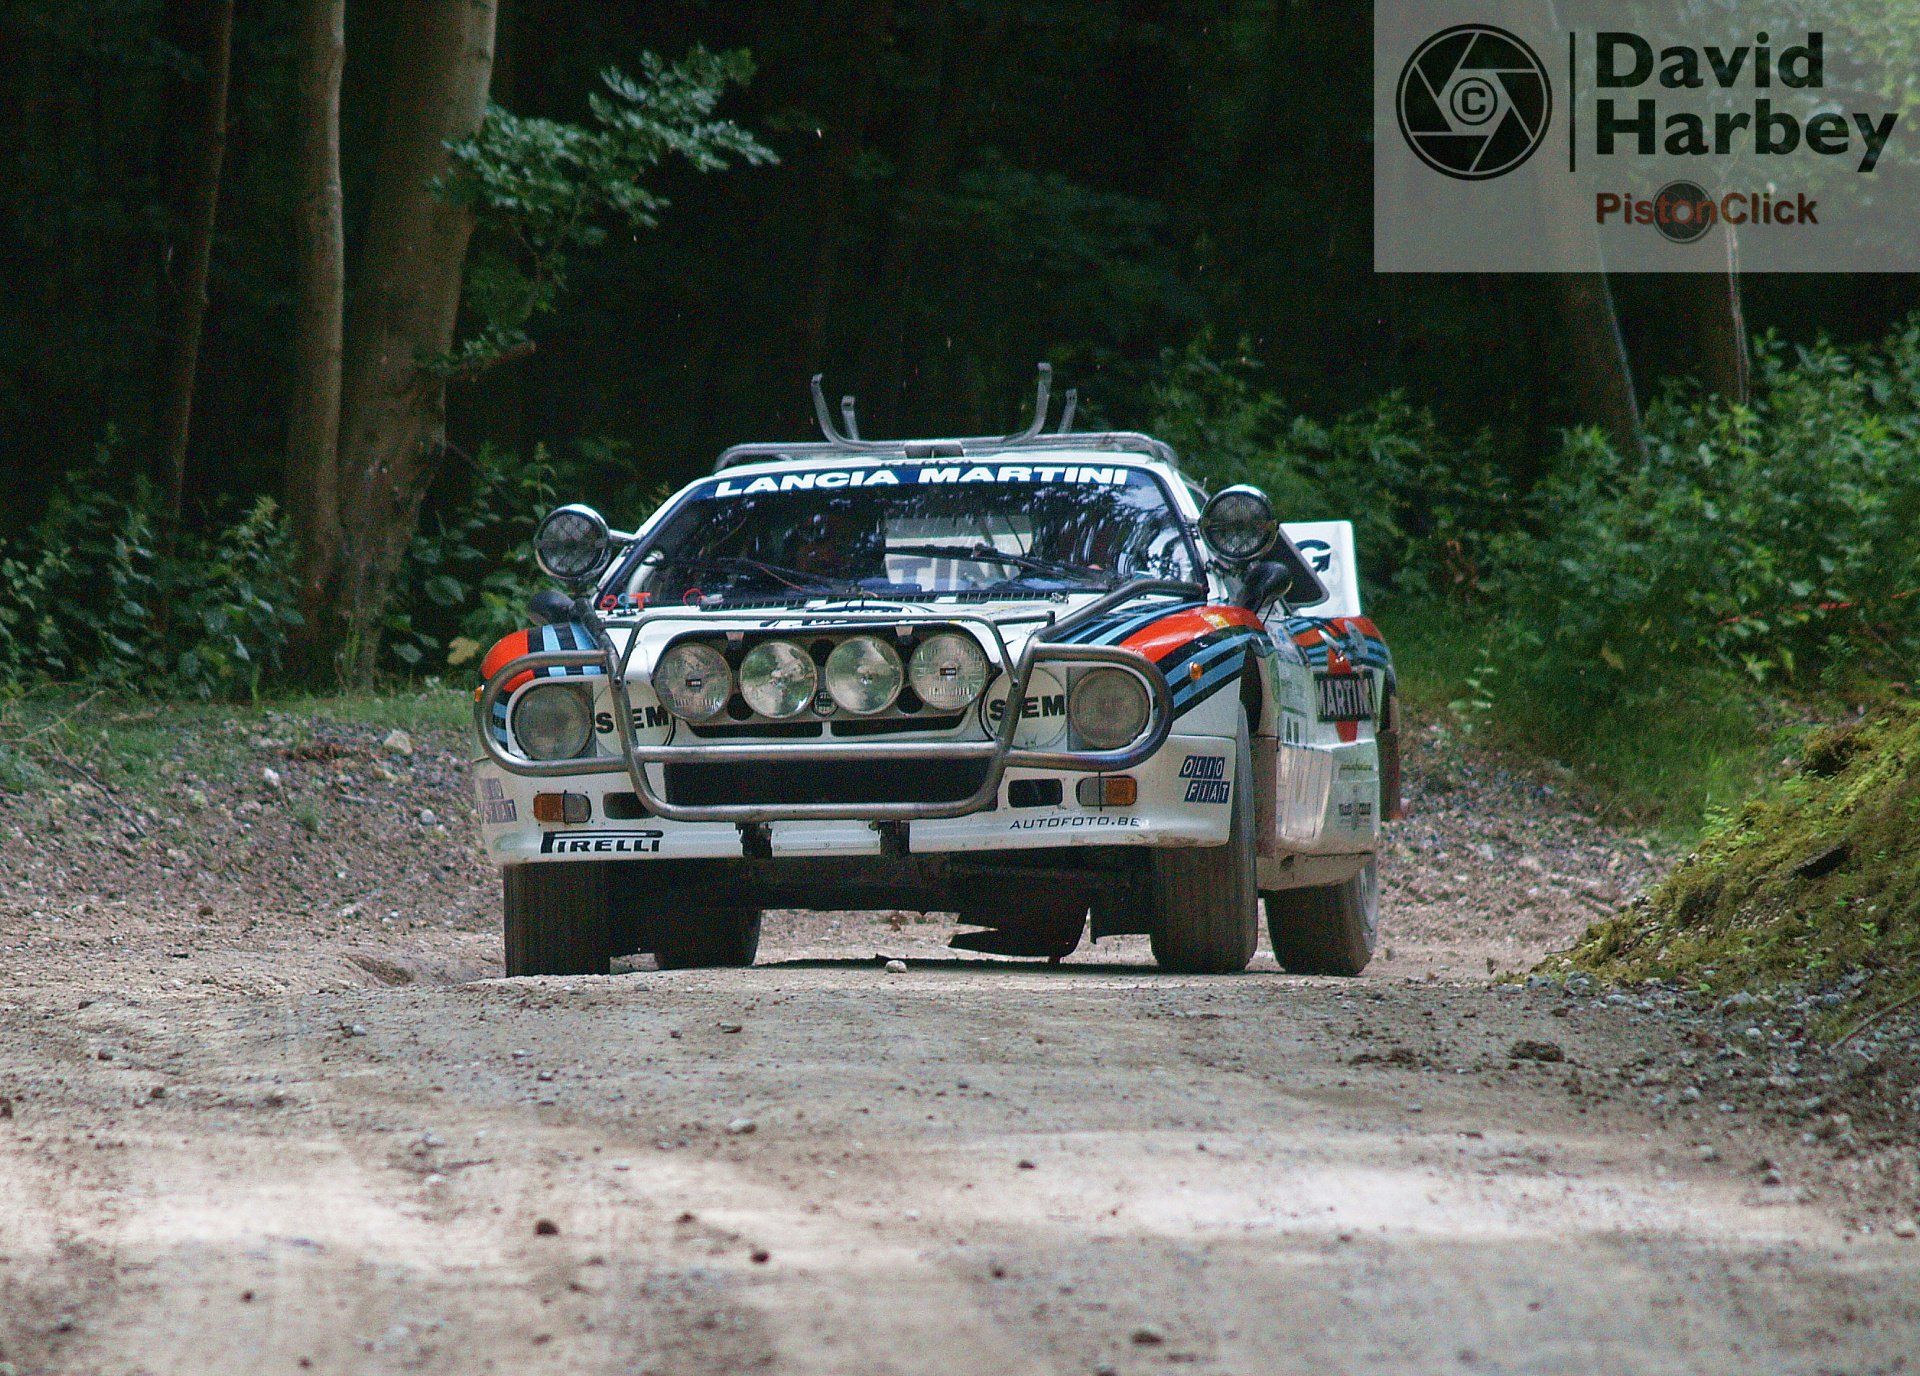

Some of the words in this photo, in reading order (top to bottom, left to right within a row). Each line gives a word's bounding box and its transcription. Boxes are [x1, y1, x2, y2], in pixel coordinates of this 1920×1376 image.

[715, 469, 899, 498] LANCIA
[918, 466, 1128, 485] MARTINI
[595, 704, 669, 734] SEM
[989, 695, 1066, 721] SEM
[1181, 757, 1224, 776] OLIO
[1186, 782, 1229, 800] FIAT
[1009, 816, 1141, 831] AUTOFOTO.BE
[540, 829, 664, 853] PIRELLI
